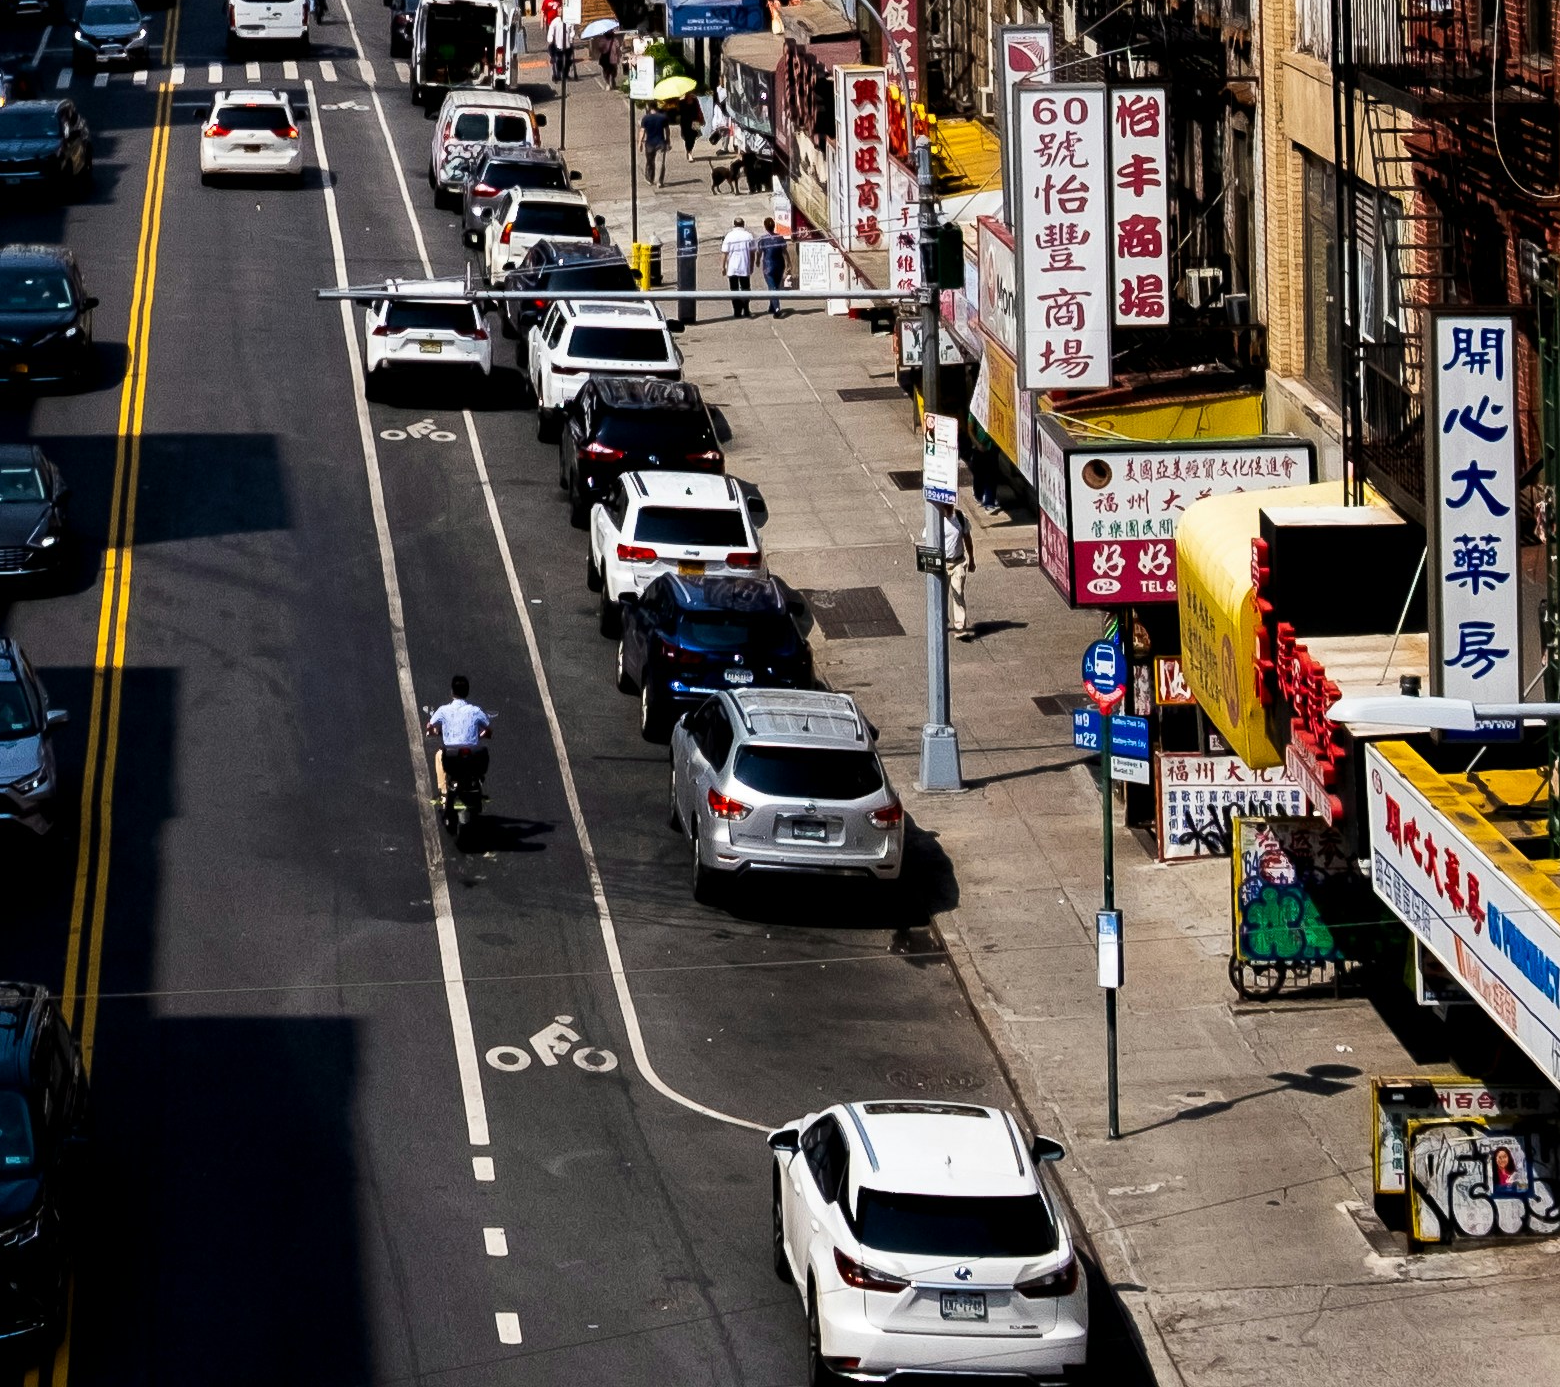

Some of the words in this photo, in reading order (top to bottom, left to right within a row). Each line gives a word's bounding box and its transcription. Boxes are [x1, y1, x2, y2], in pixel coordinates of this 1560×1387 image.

[1443, 328, 1511, 679] 開心大藥房
[1140, 580, 1163, 593] TEL
[1385, 791, 1485, 936] 開心大藥房
